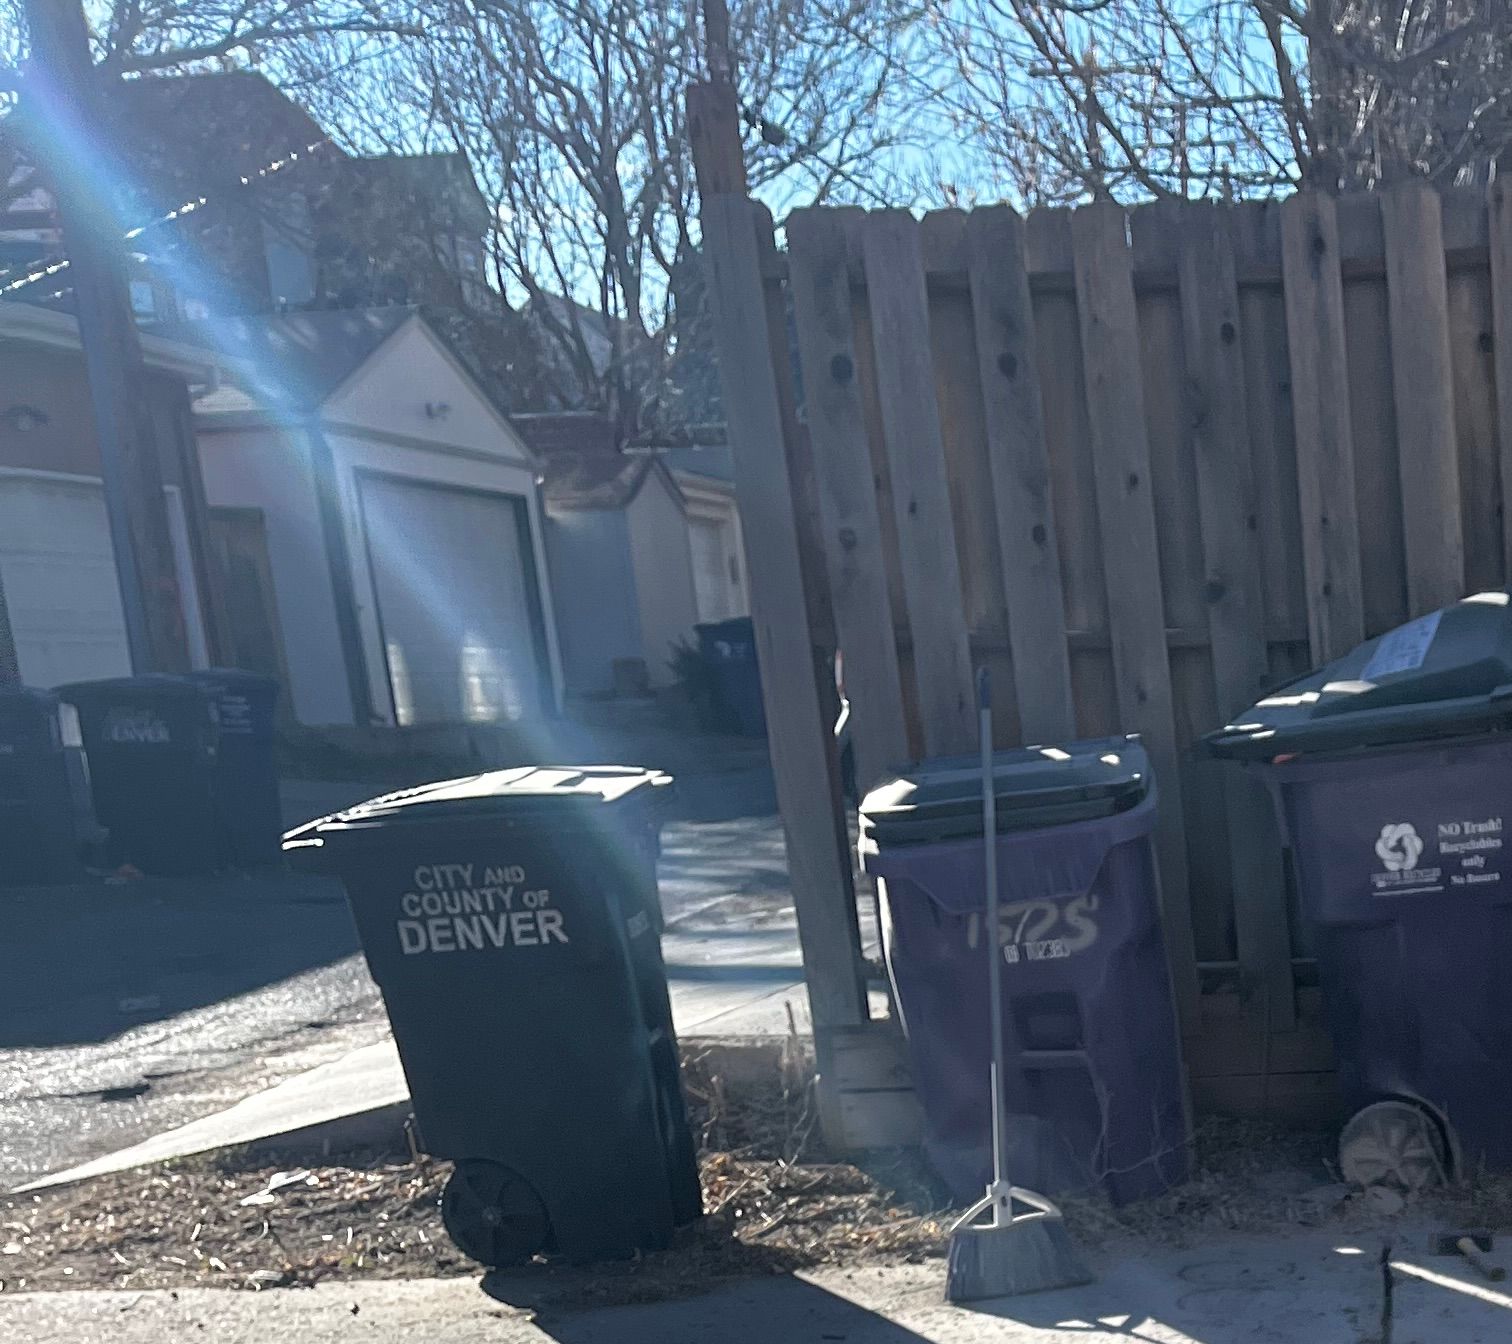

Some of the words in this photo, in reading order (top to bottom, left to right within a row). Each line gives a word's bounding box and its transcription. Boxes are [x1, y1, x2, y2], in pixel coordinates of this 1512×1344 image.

[1438, 822, 1461, 837] NO
[414, 863, 474, 890] CITY
[484, 865, 526, 886] AND
[401, 886, 514, 917] COUNTY
[522, 889, 549, 908] OF
[397, 908, 569, 955] DENVER
